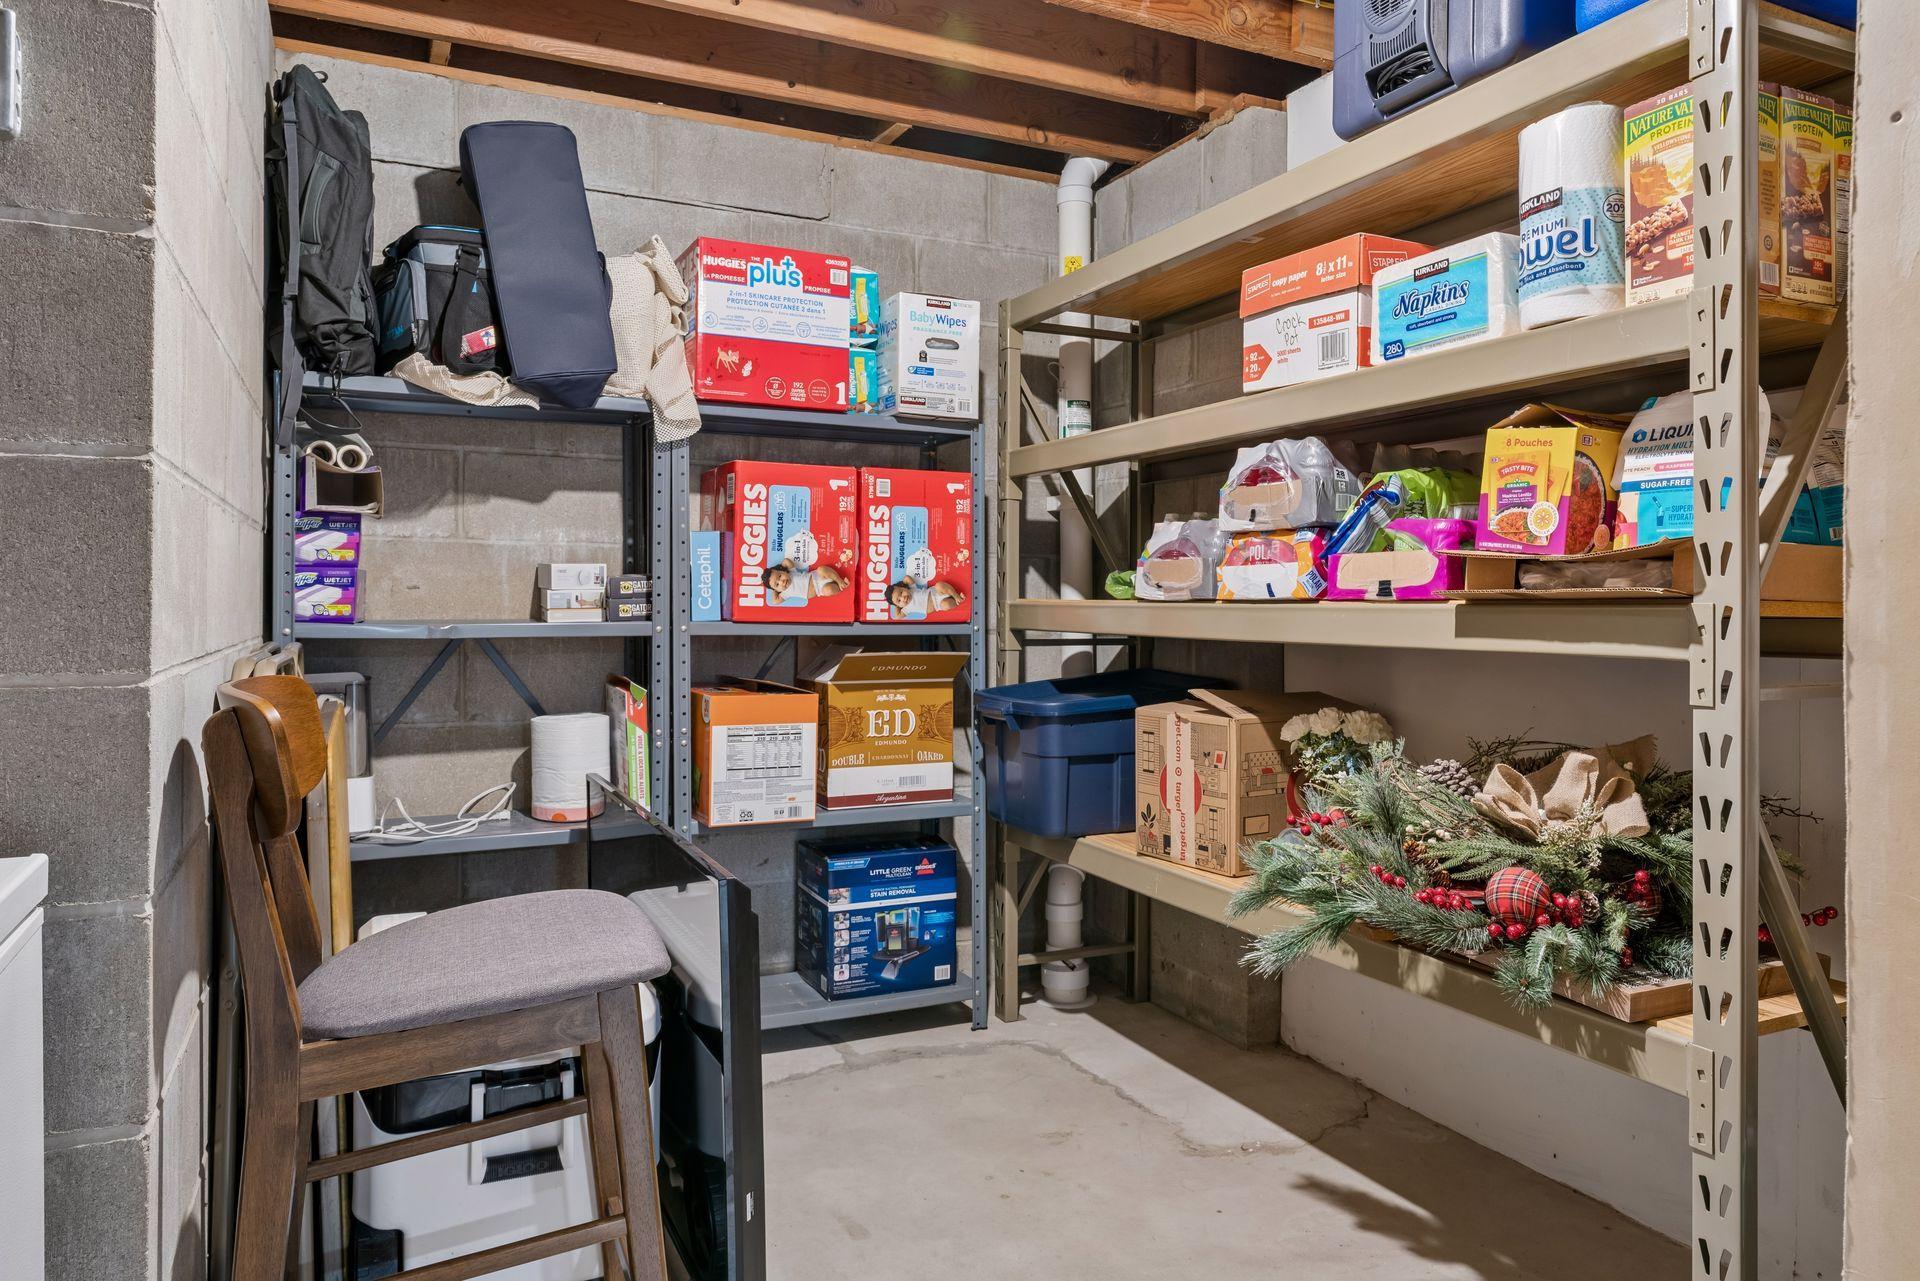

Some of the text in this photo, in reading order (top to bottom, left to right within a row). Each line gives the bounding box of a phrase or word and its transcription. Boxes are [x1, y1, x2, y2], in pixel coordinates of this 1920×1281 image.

[1656, 88, 1689, 106] 30 BARS
[1784, 102, 1832, 129] NATURE VALLEY
[1629, 106, 1674, 143] NATURE
[1649, 118, 1694, 142] PROTEIN
[1792, 123, 1824, 138] PROTEIN
[1521, 218, 1565, 243] REMIUM
[703, 255, 747, 271] HUGGIES
[1336, 255, 1347, 270] 11
[1415, 259, 1448, 276] KIRKLAND
[711, 273, 746, 283] PROMESSE
[748, 258, 802, 288] plus
[1272, 270, 1308, 288] copy paper
[1335, 271, 1347, 279] size
[804, 285, 832, 295] PROMISE
[1247, 280, 1269, 294] STAPLES
[726, 297, 770, 309] PROTECTION
[801, 306, 807, 314] 2
[808, 307, 822, 315] dans
[729, 290, 825, 309] 2-in-1 SKINCARE PROTECTION
[928, 299, 951, 307] KIRKLAND
[1392, 279, 1470, 320] Napkins
[1386, 342, 1403, 355] 280
[1249, 351, 1258, 362] 92
[1249, 363, 1258, 373] 20
[793, 381, 804, 389] 192
[835, 381, 847, 405] 1
[1506, 438, 1554, 448] 8 Pouches
[1627, 443, 1670, 456] HYDRATION
[1501, 463, 1535, 475] TASTY BITE
[829, 479, 848, 491] 1
[946, 483, 965, 494] 1
[1641, 478, 1692, 489] SUGAR-FREE
[839, 496, 847, 512] 192
[956, 499, 964, 514] 192
[776, 512, 785, 552] SNUGGLERS
[739, 483, 768, 607] HUGGIES
[866, 505, 890, 620] HUGGIES
[1306, 570, 1323, 592] POLAR
[866, 708, 915, 737] ED
[832, 753, 864, 766] DOUBLE
[917, 751, 944, 761] OAKED
[875, 794, 907, 803] Argentina
[869, 868, 891, 876] LITTLE
[870, 889, 888, 898] STAIN
[888, 887, 916, 896] REMOVAL
